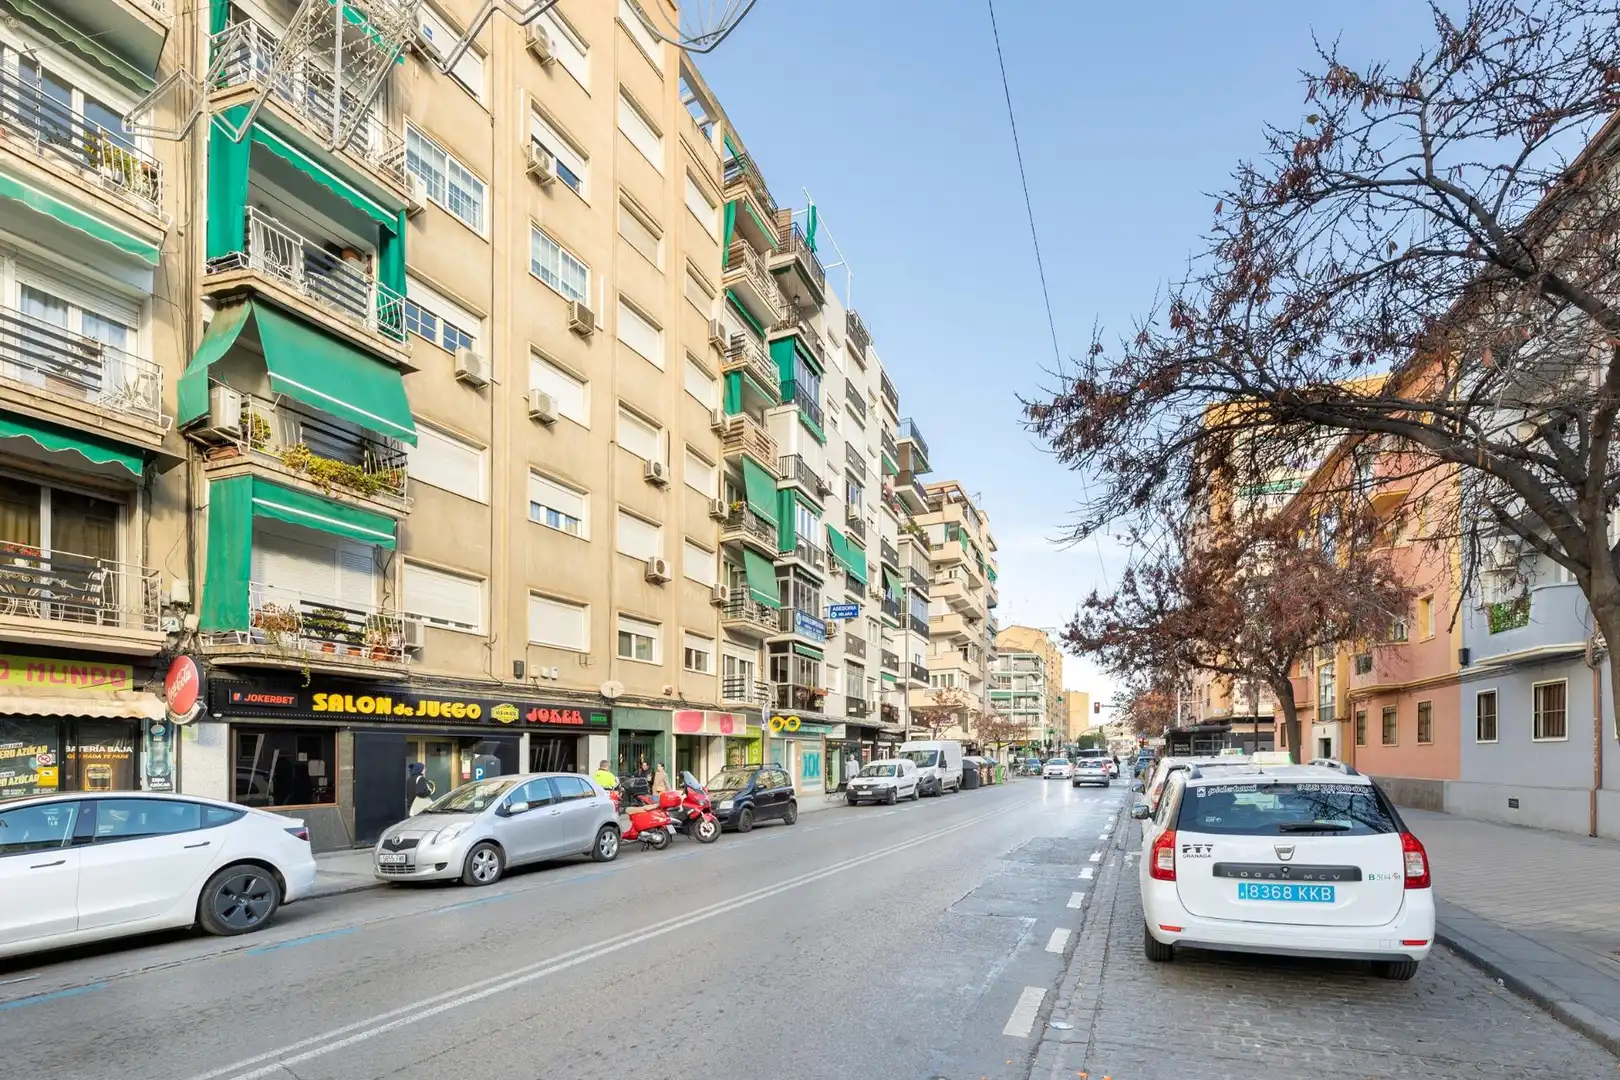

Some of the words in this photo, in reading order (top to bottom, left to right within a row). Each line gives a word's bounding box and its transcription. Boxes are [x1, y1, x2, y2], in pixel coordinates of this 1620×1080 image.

[26, 662, 126, 687] MUNDO
[243, 694, 295, 705] JOKERBET
[312, 693, 392, 715] SALON
[393, 703, 414, 717] de
[416, 700, 482, 720] JUEGO
[526, 707, 584, 725] JOKER
[475, 767, 484, 780] P
[1227, 871, 1290, 879] LOGAN
[1249, 884, 1293, 899] 8368
[1299, 886, 1333, 901] KKB
